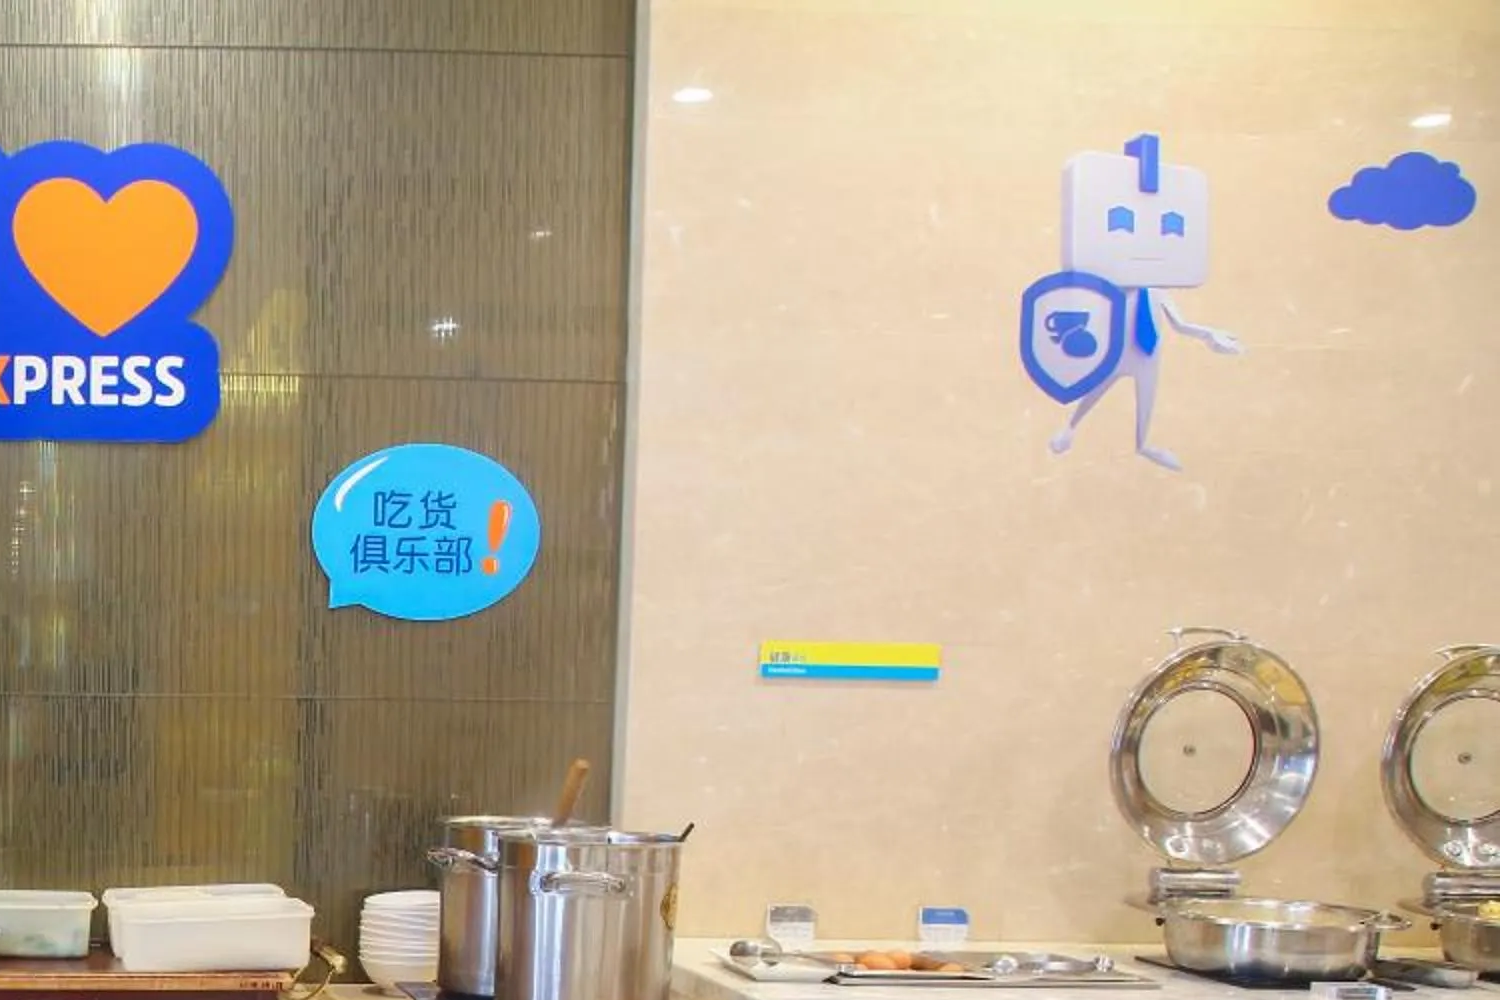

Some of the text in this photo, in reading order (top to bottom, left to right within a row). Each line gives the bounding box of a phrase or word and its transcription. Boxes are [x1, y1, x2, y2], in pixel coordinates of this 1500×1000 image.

[372, 489, 458, 531] 吃货
[349, 533, 474, 577] 俱乐部
